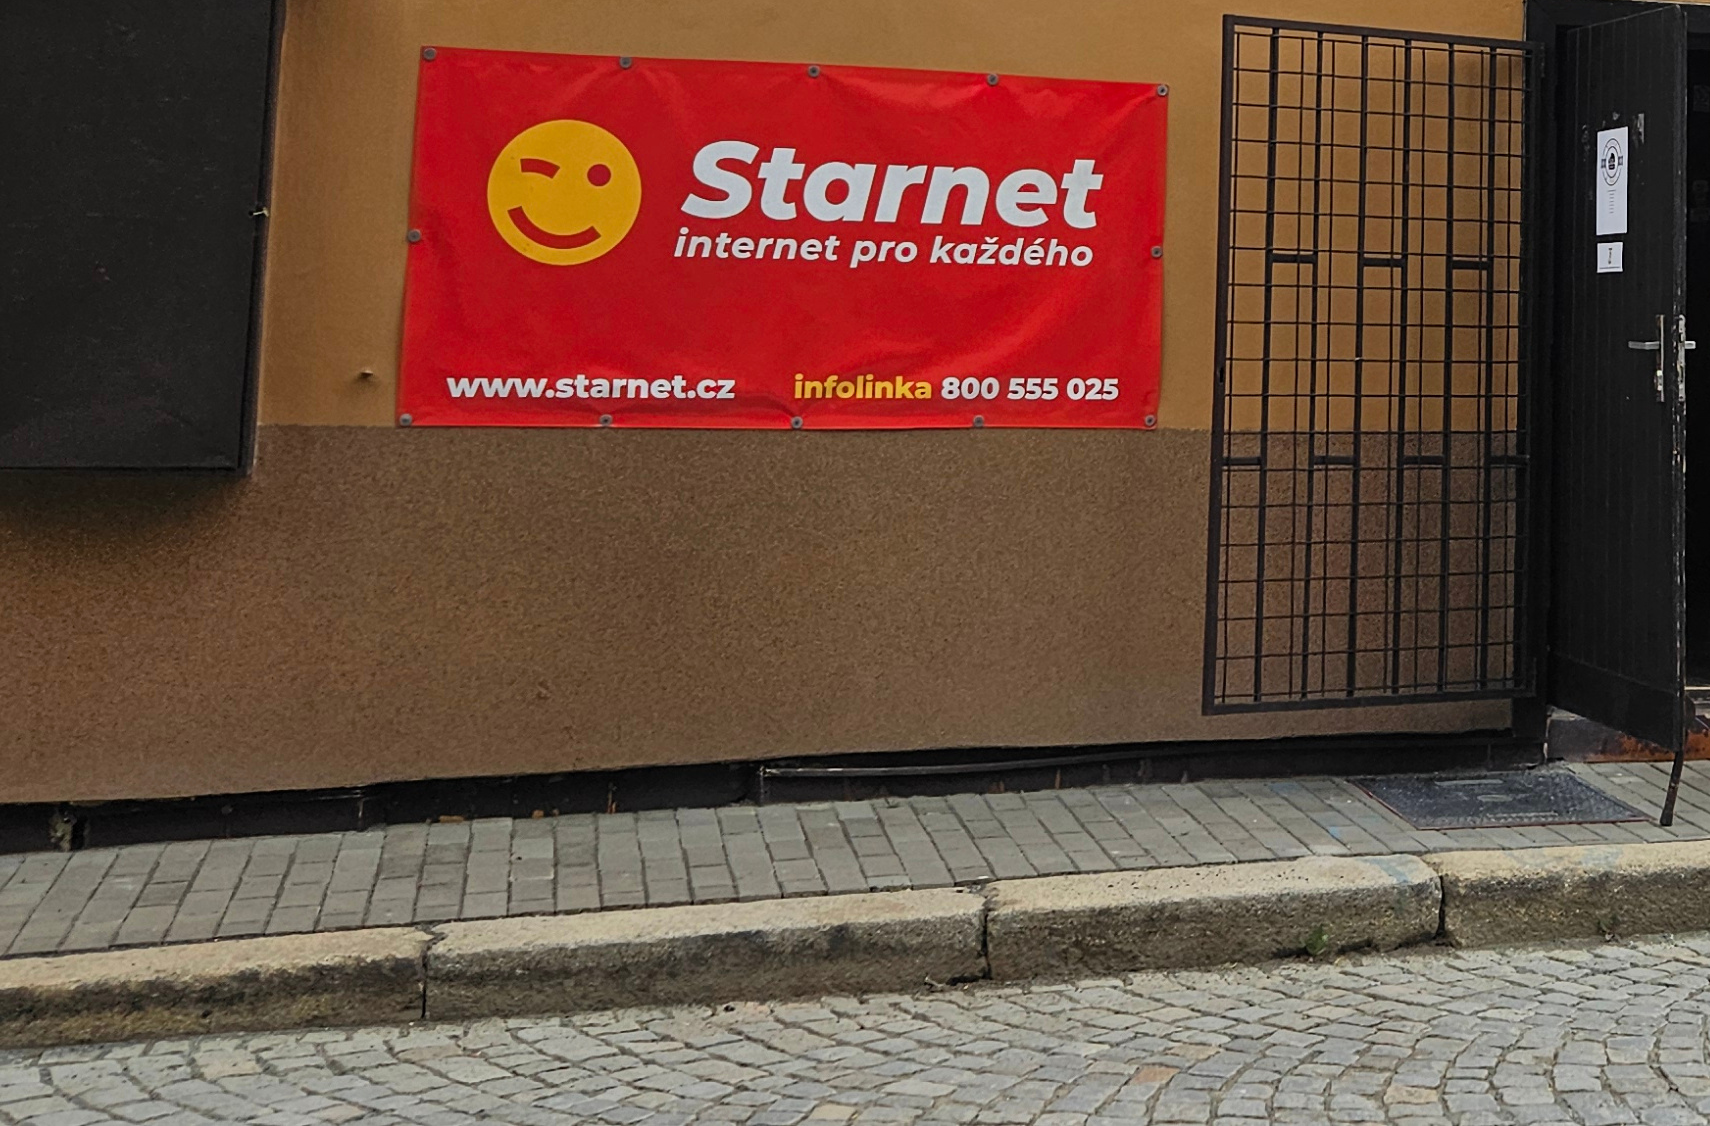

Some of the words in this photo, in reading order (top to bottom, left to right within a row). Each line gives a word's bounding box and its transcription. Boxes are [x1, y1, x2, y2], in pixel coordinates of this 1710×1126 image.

[680, 139, 1104, 229] Starnet
[673, 226, 841, 262] internet
[849, 240, 918, 269] pro
[929, 235, 1093, 268] každého
[446, 374, 736, 400] www.starnet.cz
[795, 373, 932, 400] infolinka
[941, 376, 1000, 400] 800
[1006, 377, 1059, 401] 555
[1066, 377, 1119, 401] 025
